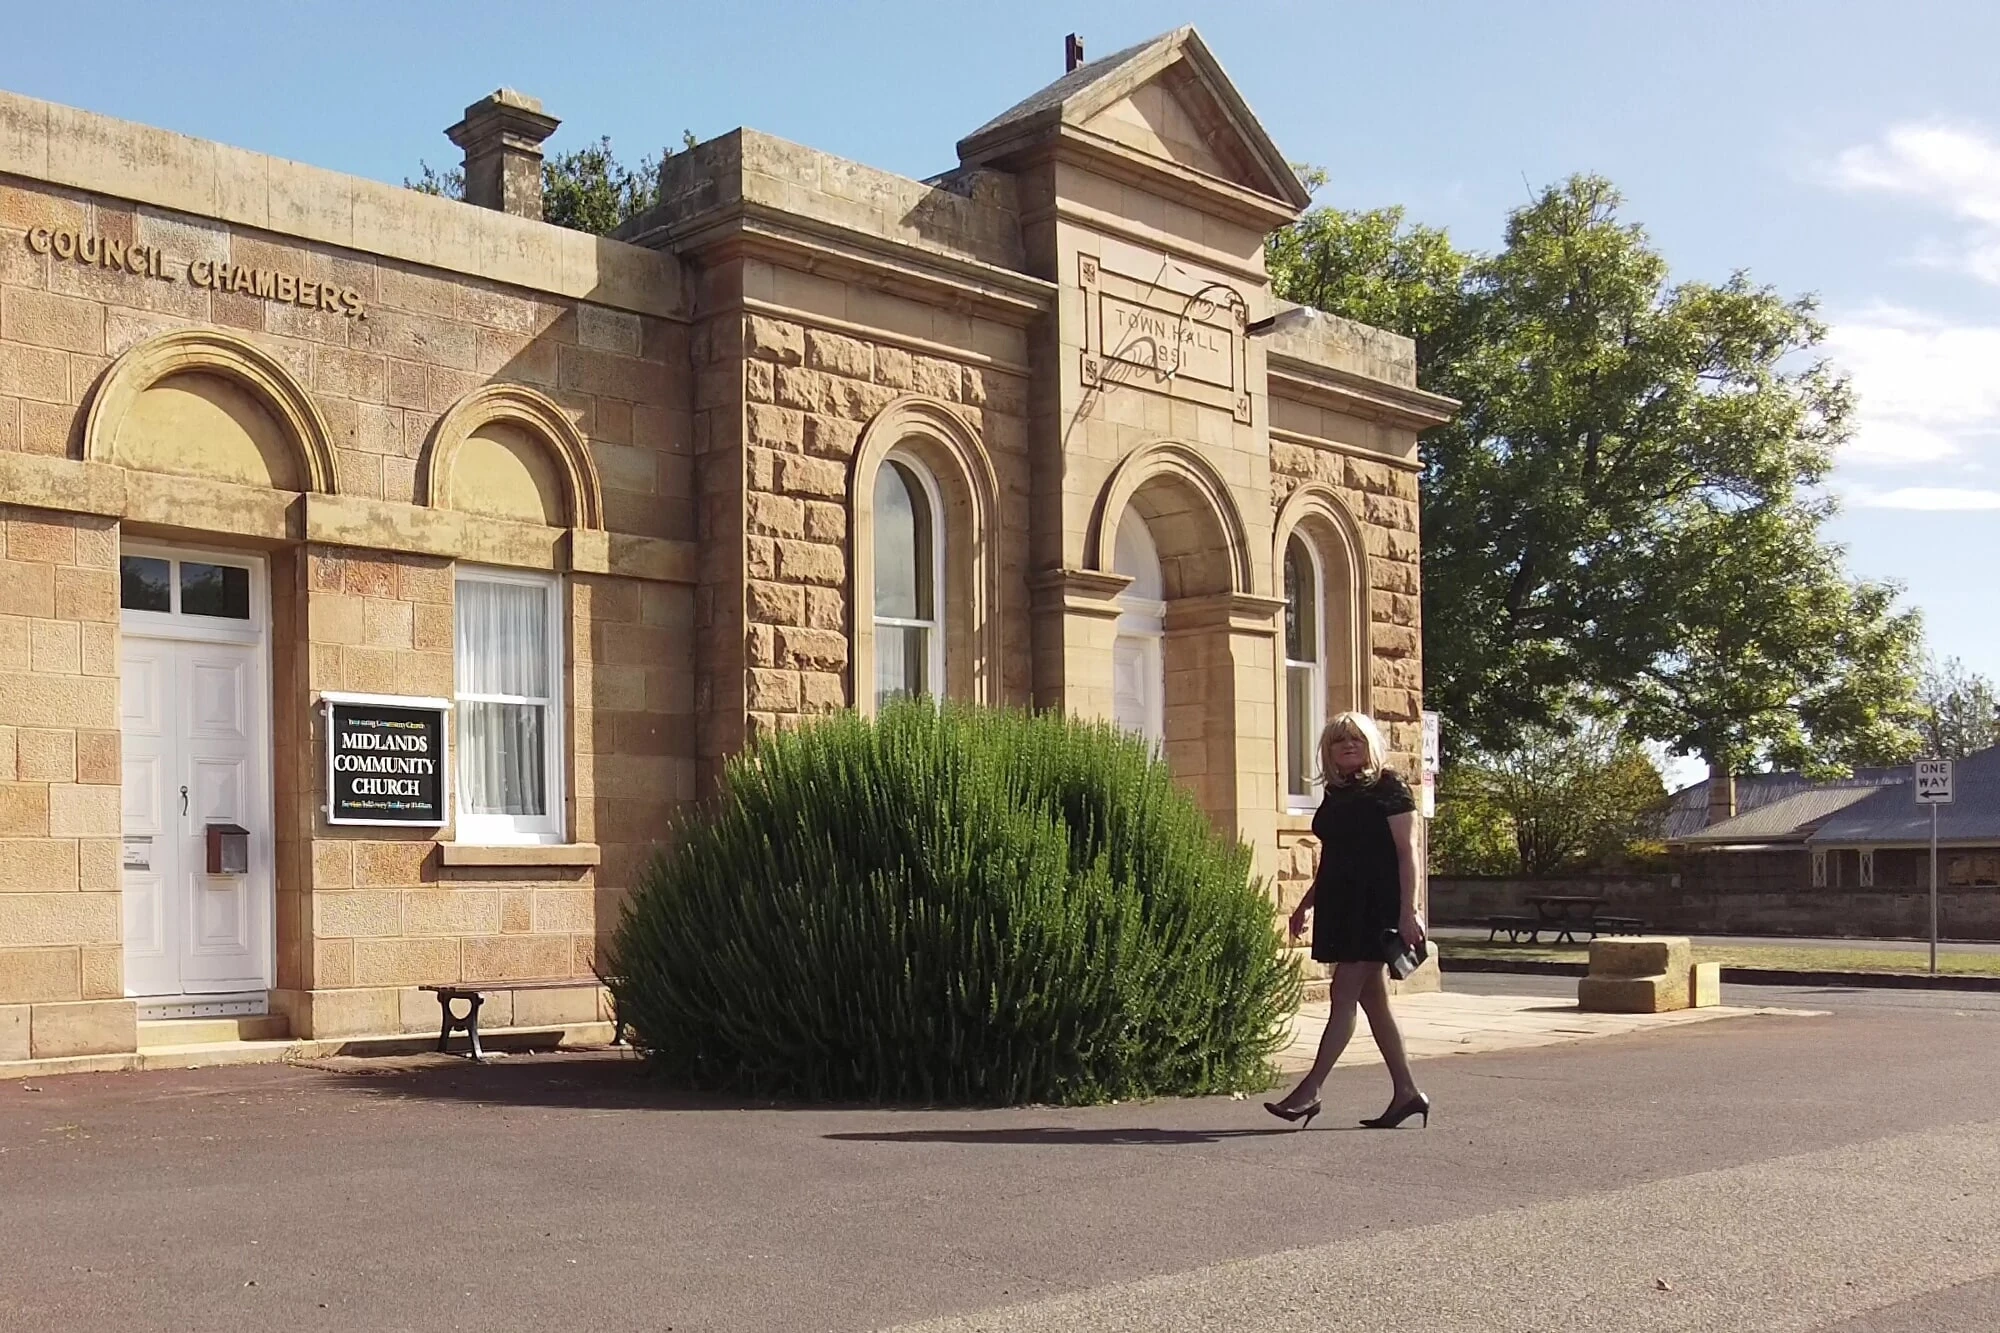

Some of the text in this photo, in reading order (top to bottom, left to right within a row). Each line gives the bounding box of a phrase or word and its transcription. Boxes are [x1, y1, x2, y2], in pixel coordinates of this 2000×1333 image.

[26, 224, 175, 282] COUNCIL
[341, 732, 428, 753] MIDLANDS
[334, 754, 437, 775] COMMUNITY
[1920, 763, 1948, 774] ONE
[351, 778, 420, 796] CHURCH
[1918, 777, 1949, 788] WAY
